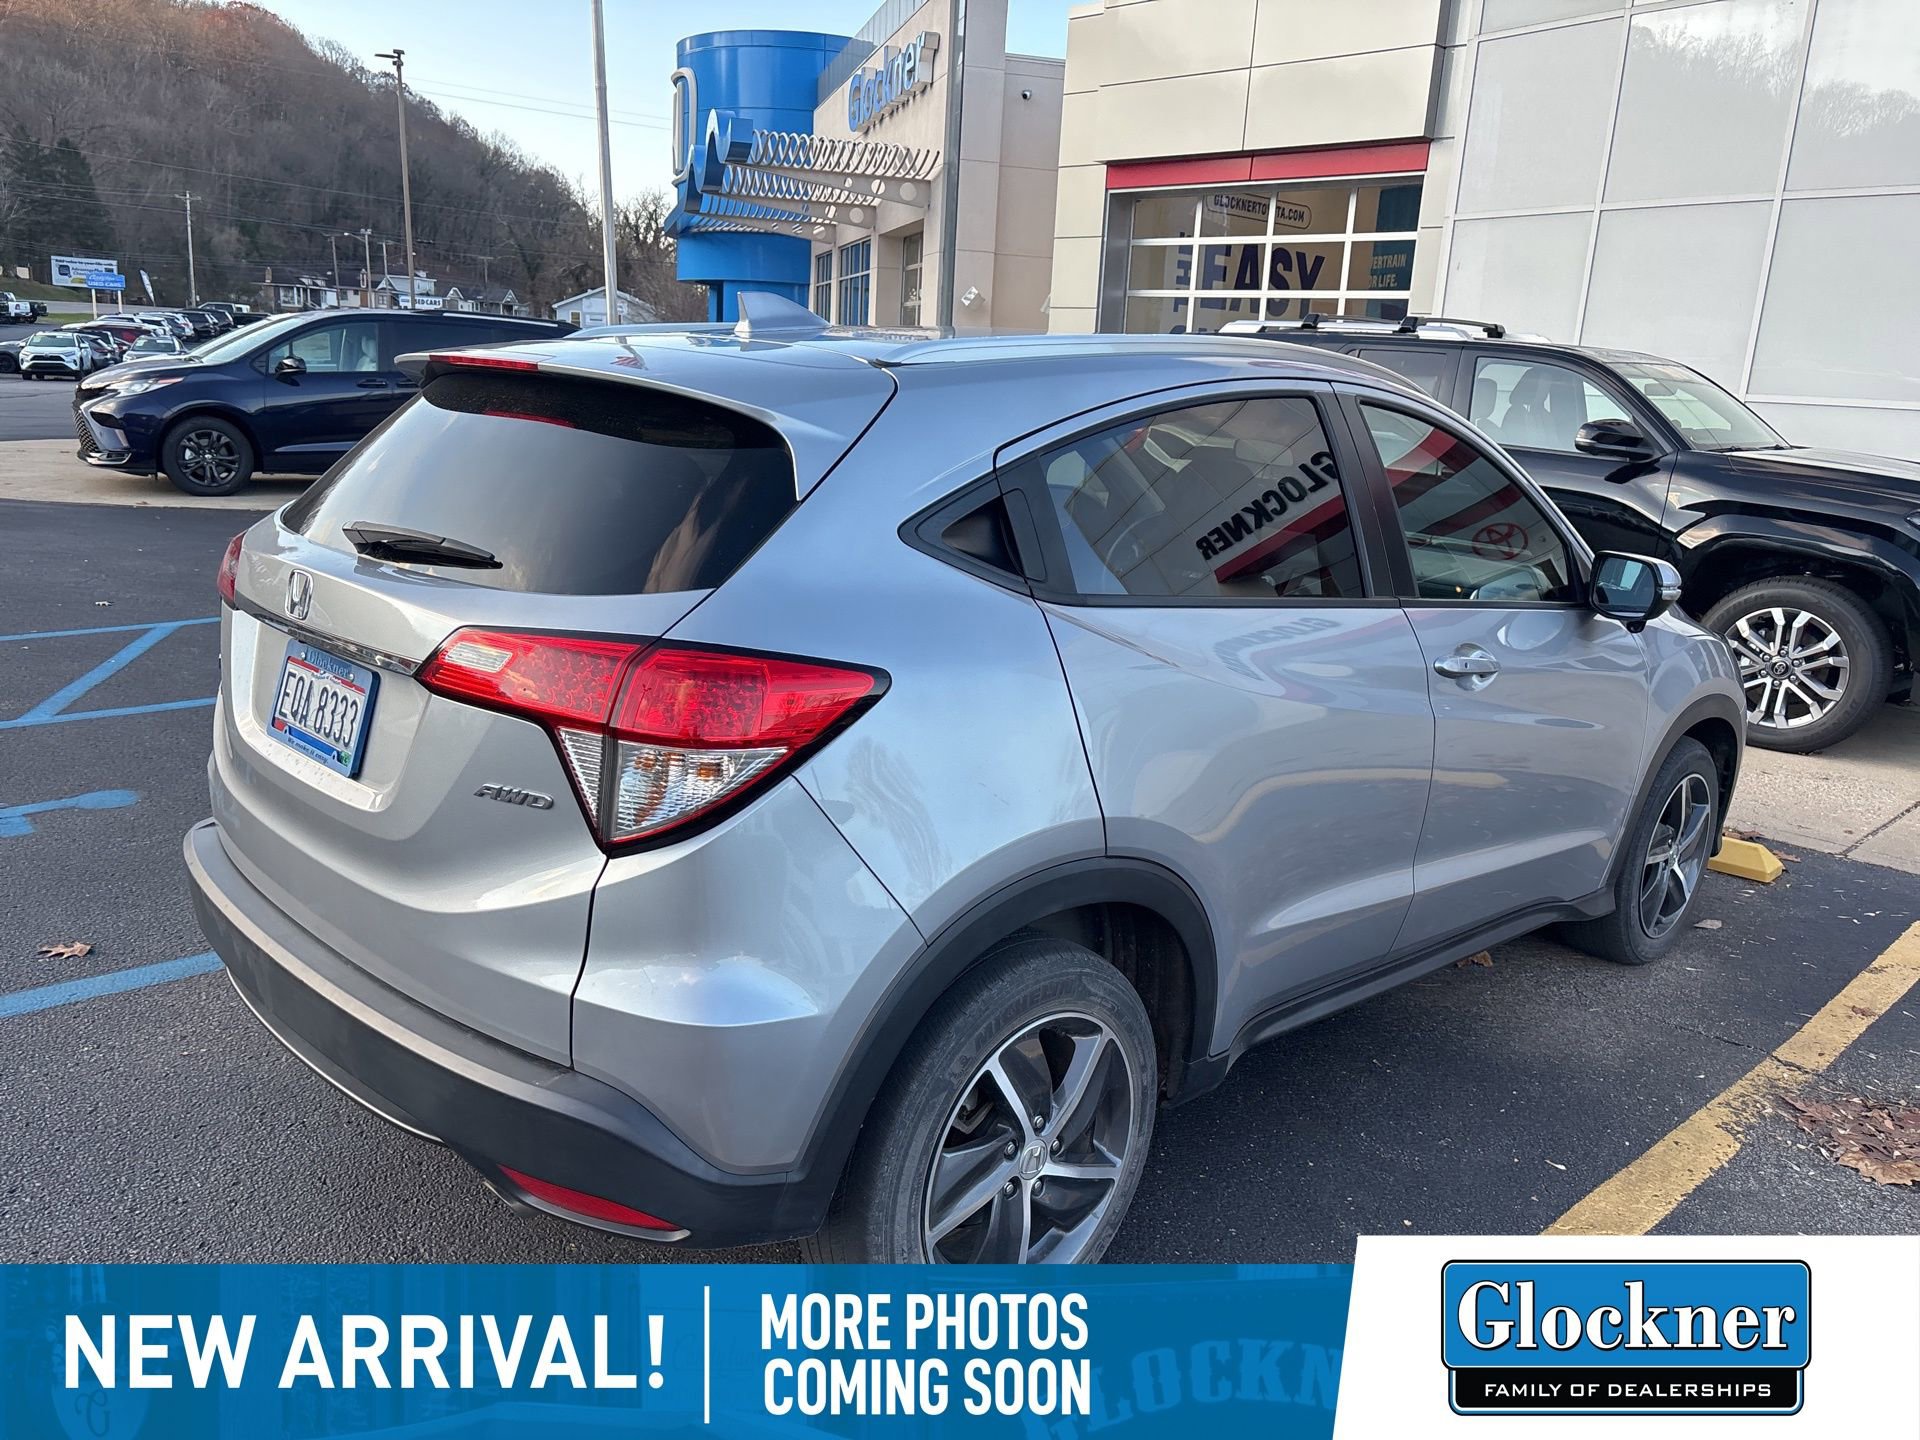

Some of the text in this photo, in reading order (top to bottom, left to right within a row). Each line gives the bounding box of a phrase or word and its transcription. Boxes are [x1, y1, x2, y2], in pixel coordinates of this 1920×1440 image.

[848, 31, 932, 132] Glockner
[1213, 194, 1305, 223] GLOCKNERTOTA.COM
[1200, 243, 1326, 319] EASY
[426, 298, 441, 306] CARS
[308, 650, 350, 678] Glockner
[278, 669, 359, 749] EQA 8333
[473, 783, 554, 810] AWD
